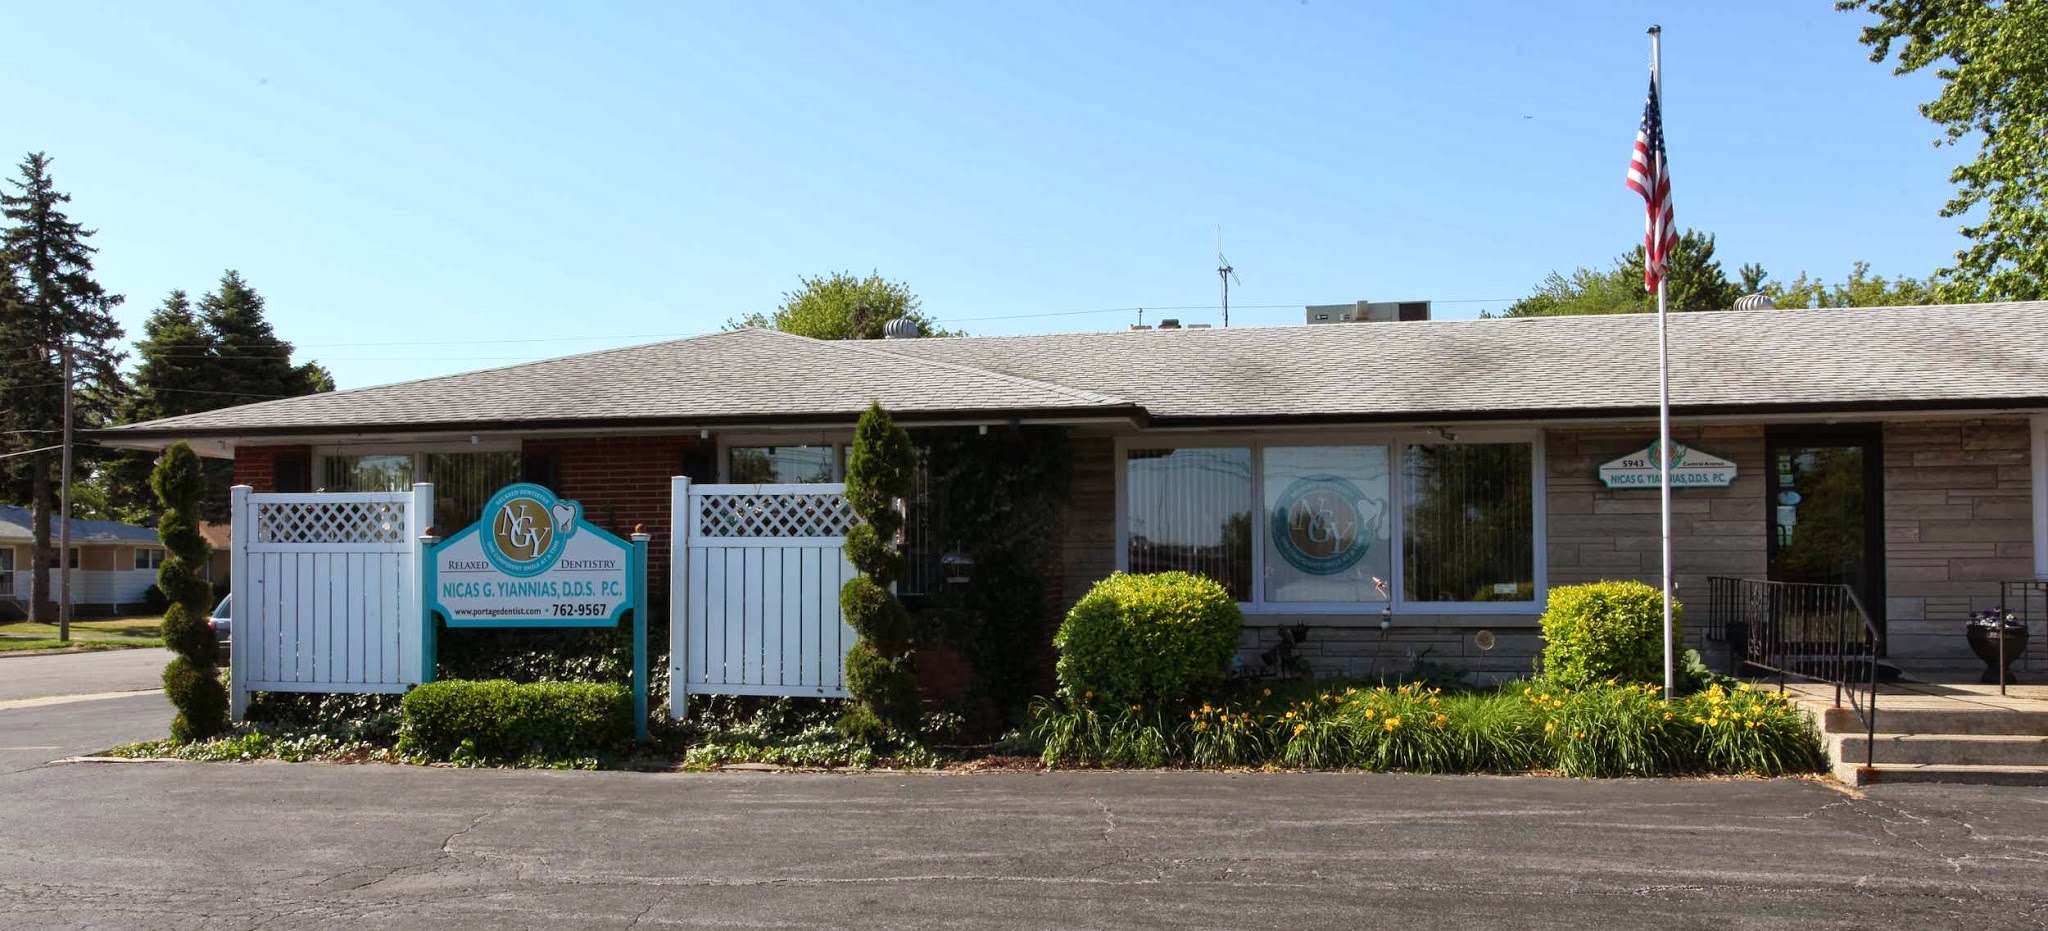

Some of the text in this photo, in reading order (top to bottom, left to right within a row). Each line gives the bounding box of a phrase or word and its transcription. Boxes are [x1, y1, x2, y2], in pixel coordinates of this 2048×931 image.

[1622, 460, 1644, 468] 5943
[1611, 475, 1635, 484] NICAS
[1637, 474, 1645, 483] G.
[1647, 474, 1687, 484] YIAIAS,
[1713, 473, 1727, 482] P.C.
[499, 505, 551, 559] NGY
[443, 581, 623, 599] NICAS G. YIANNIAS, D.D.S. P.C.
[455, 607, 542, 616] www.portagedentist.com
[552, 603, 607, 616] 762-9567
